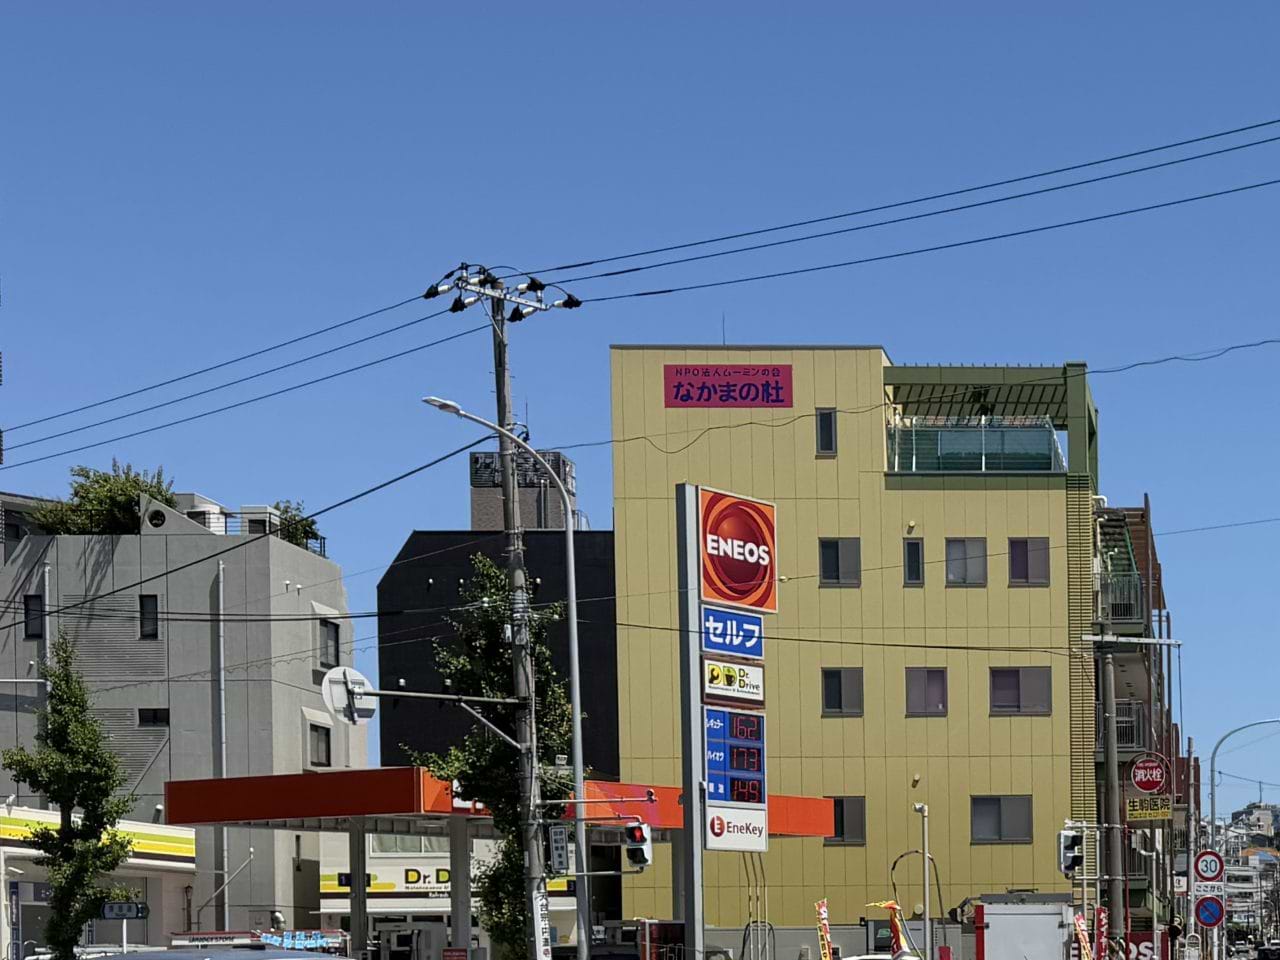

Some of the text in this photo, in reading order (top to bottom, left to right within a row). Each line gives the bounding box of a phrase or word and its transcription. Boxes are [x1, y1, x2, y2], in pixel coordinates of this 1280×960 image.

[673, 380, 785, 403] なかまの杜
[706, 533, 770, 566] ENEOS
[705, 615, 760, 648] セルフ
[738, 679, 761, 691] Drive
[733, 716, 758, 740] 162
[733, 748, 758, 771] 173
[1135, 767, 1162, 782] 消火栓
[734, 780, 759, 802] 149
[726, 821, 764, 838] EneKey
[404, 868, 432, 884] Dr.
[1201, 859, 1218, 874] 30
[1195, 885, 1223, 893] ここから
